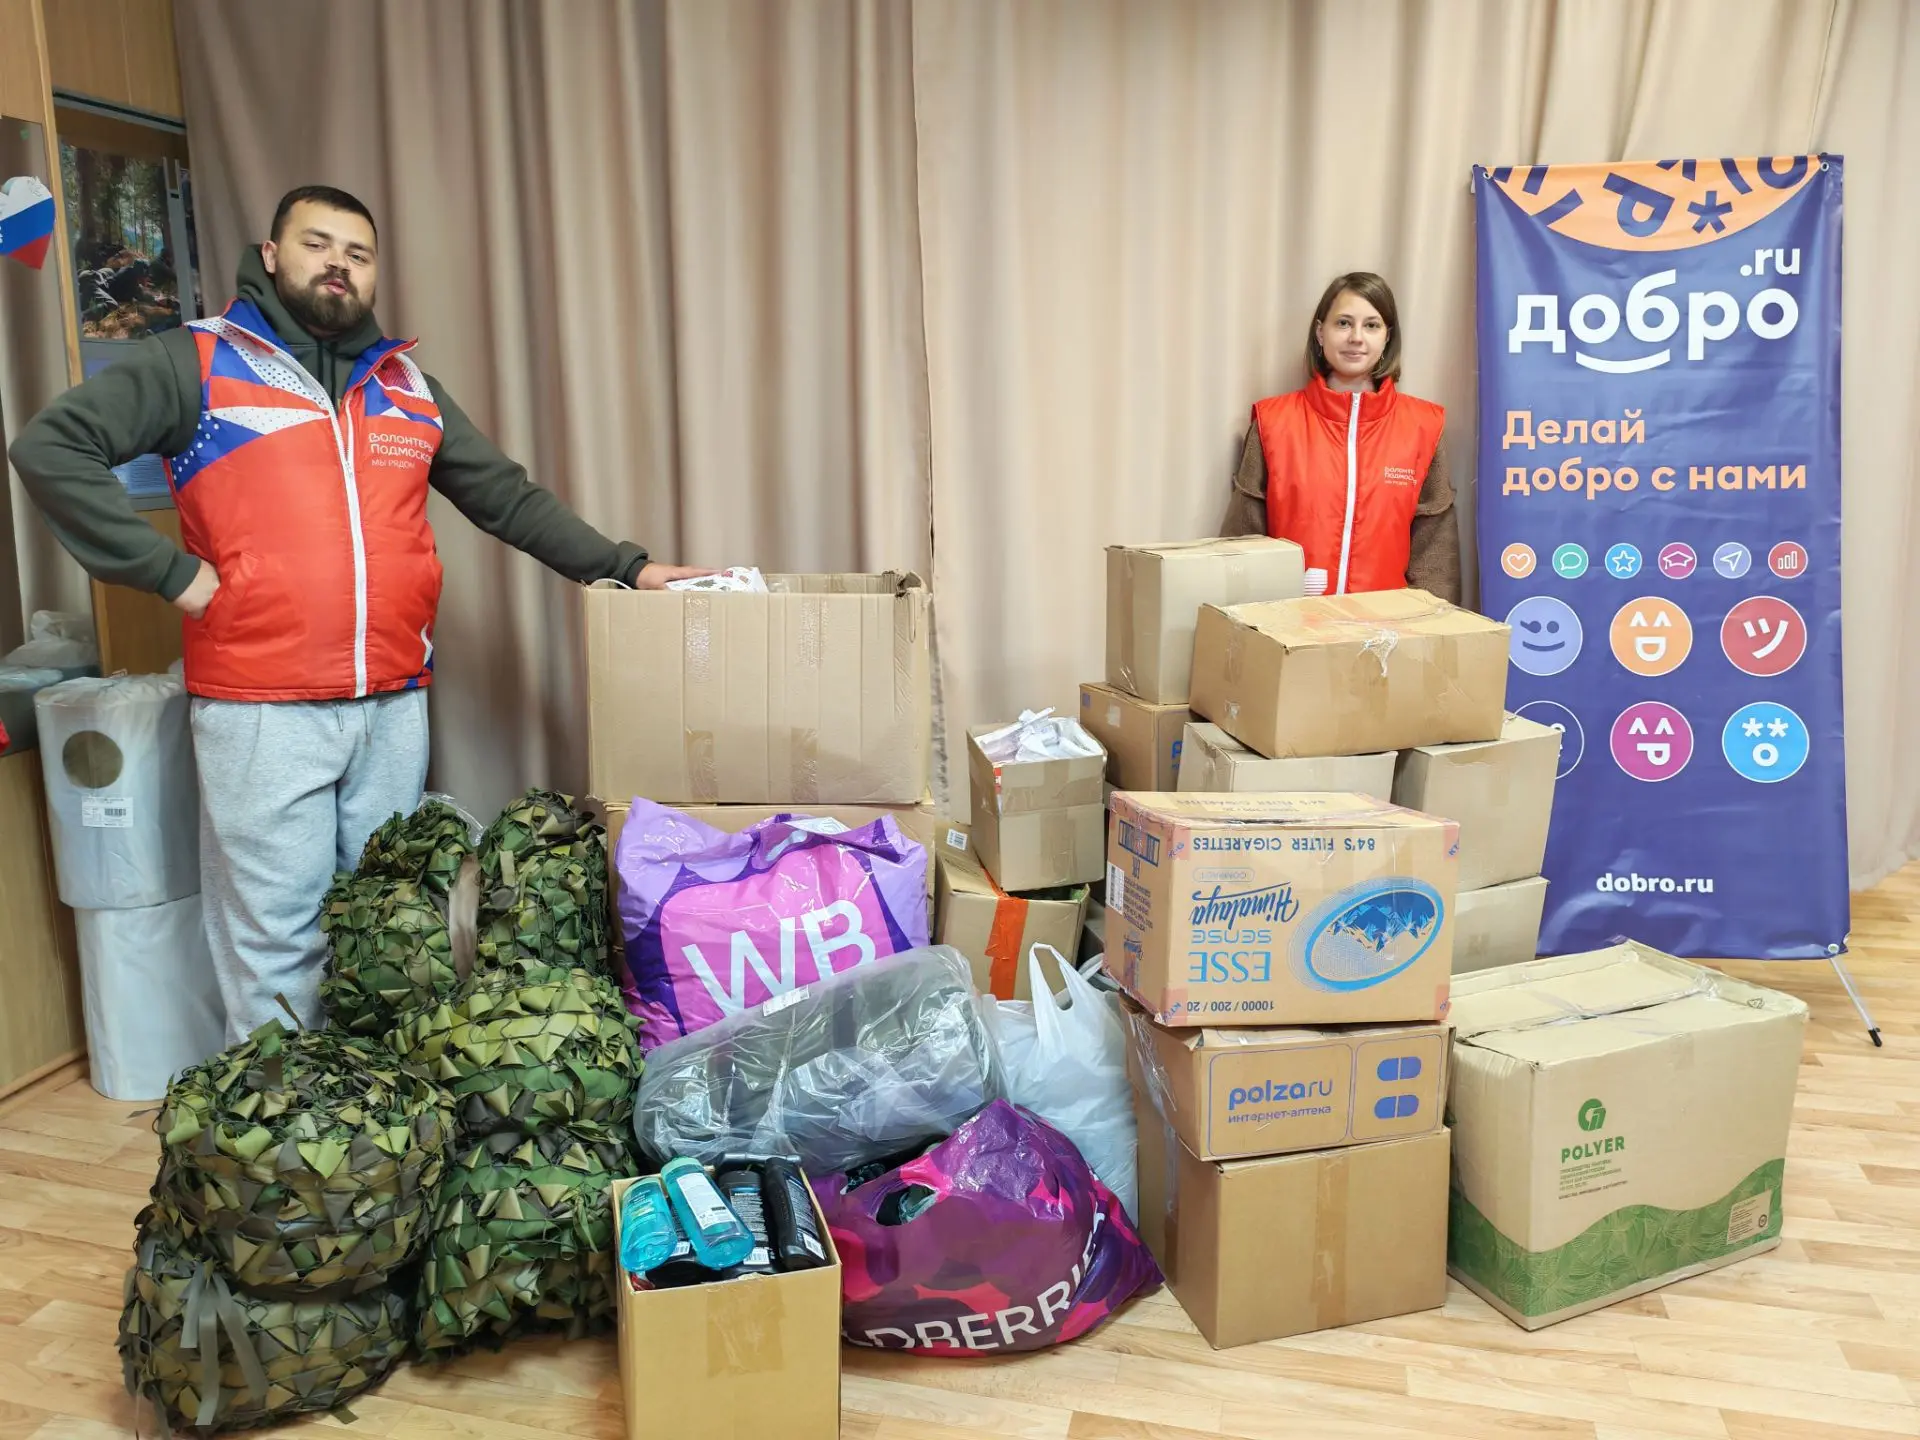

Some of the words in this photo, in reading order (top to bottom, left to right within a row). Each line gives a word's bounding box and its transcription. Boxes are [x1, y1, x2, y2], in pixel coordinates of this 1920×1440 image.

[1739, 248, 1800, 276] .ru
[1508, 268, 1799, 361] добро
[1502, 408, 1645, 450] Делай
[1502, 457, 1639, 500] добро
[1651, 466, 1677, 490] с
[1688, 464, 1807, 490] нами
[1192, 837, 1282, 851] CIGARETTES
[1292, 837, 1335, 851] FILTER
[1345, 837, 1375, 851] 84'S
[1596, 873, 1715, 893] dobro.ru
[1187, 883, 1300, 931] Himalaya
[1187, 951, 1272, 984] ESSE
[1186, 1001, 1201, 1013] 20
[1210, 1002, 1232, 1013] 200
[1241, 1001, 1275, 1013] 10000
[1228, 1105, 1332, 1123] интернет-аптека
[1561, 1136, 1625, 1164] POLYER
